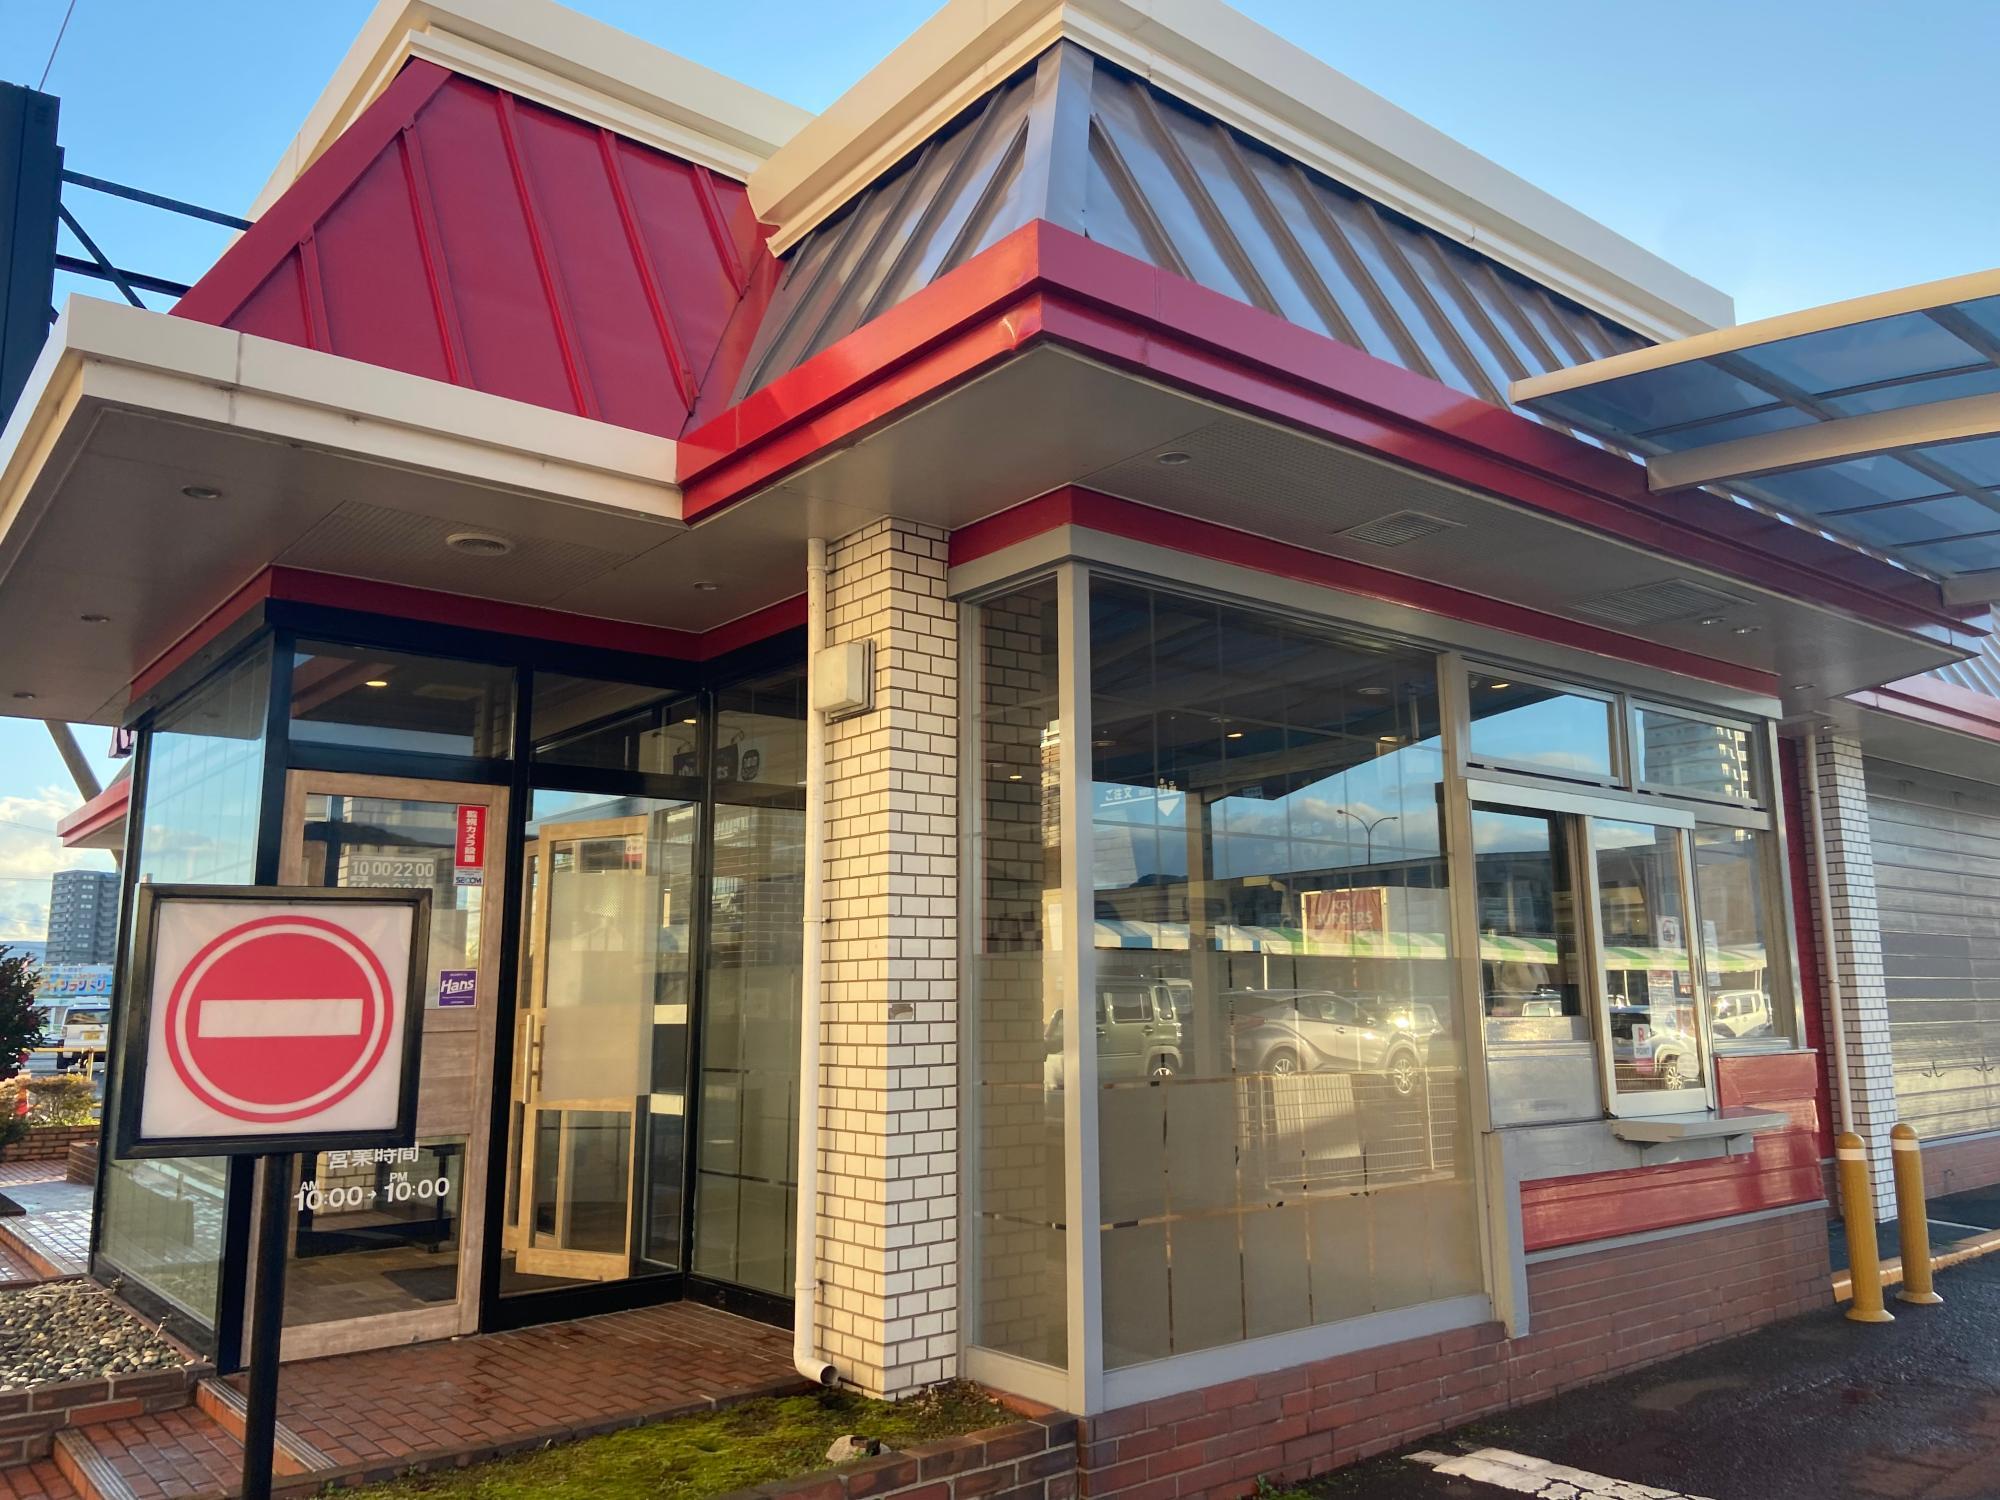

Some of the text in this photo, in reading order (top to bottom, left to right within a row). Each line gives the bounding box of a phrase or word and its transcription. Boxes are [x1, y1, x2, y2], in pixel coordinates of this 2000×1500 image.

[455, 876, 482, 884] SECOM
[441, 979, 475, 994] Hans
[300, 1172, 408, 1191] AM PM
[293, 1177, 450, 1211] 10:00 10:00
